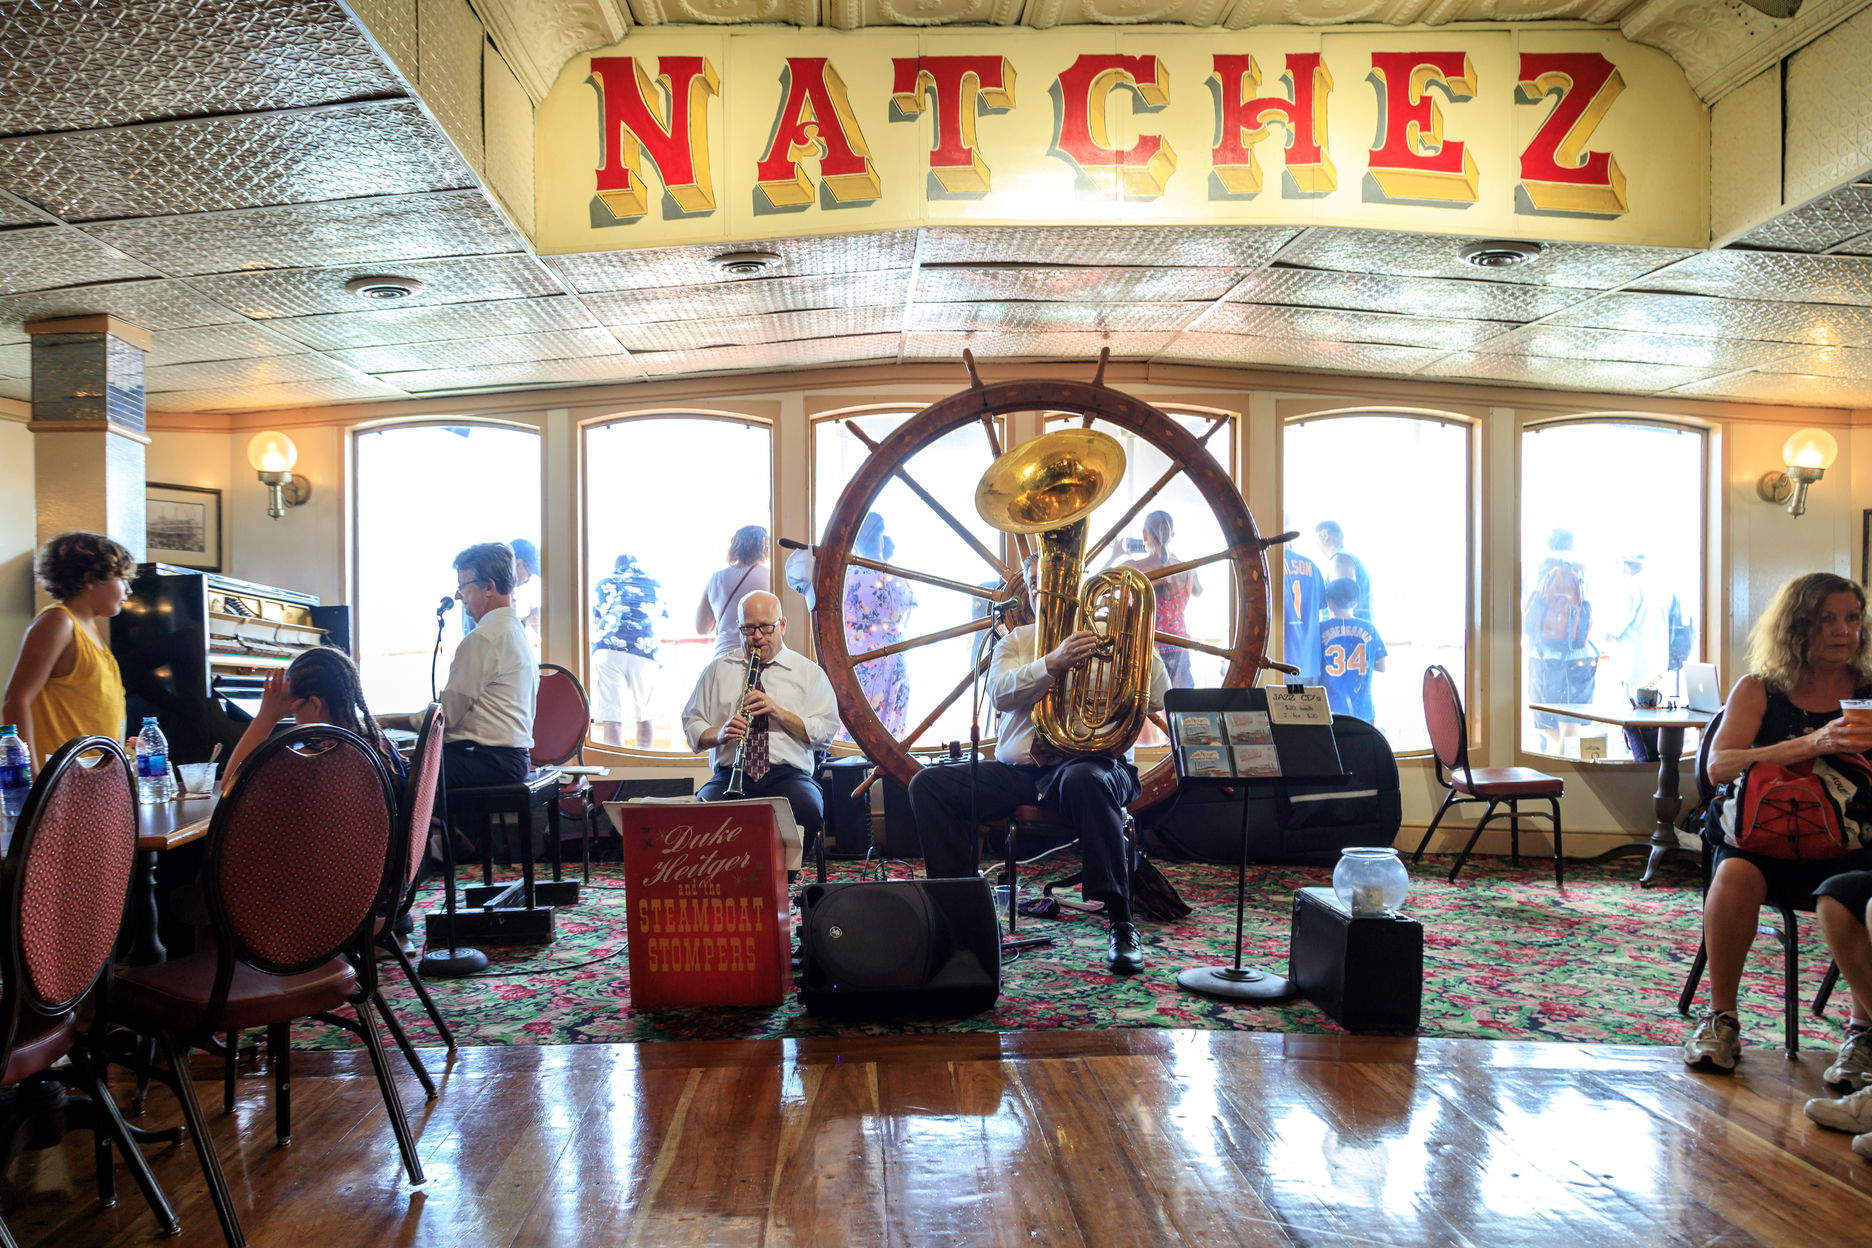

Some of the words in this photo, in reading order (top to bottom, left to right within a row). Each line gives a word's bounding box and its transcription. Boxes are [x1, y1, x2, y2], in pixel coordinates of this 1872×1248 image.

[584, 51, 1630, 228] NATCHEZ
[1292, 580, 1302, 620] 1
[1324, 643, 1368, 677] 34
[1272, 693, 1296, 701] JAZZ
[661, 816, 743, 854] Duke
[642, 850, 751, 888] Heitger
[678, 878, 698, 896] and
[703, 879, 721, 896] the
[639, 897, 764, 934] STEAMBOAT
[648, 936, 757, 973] STOMPERS
